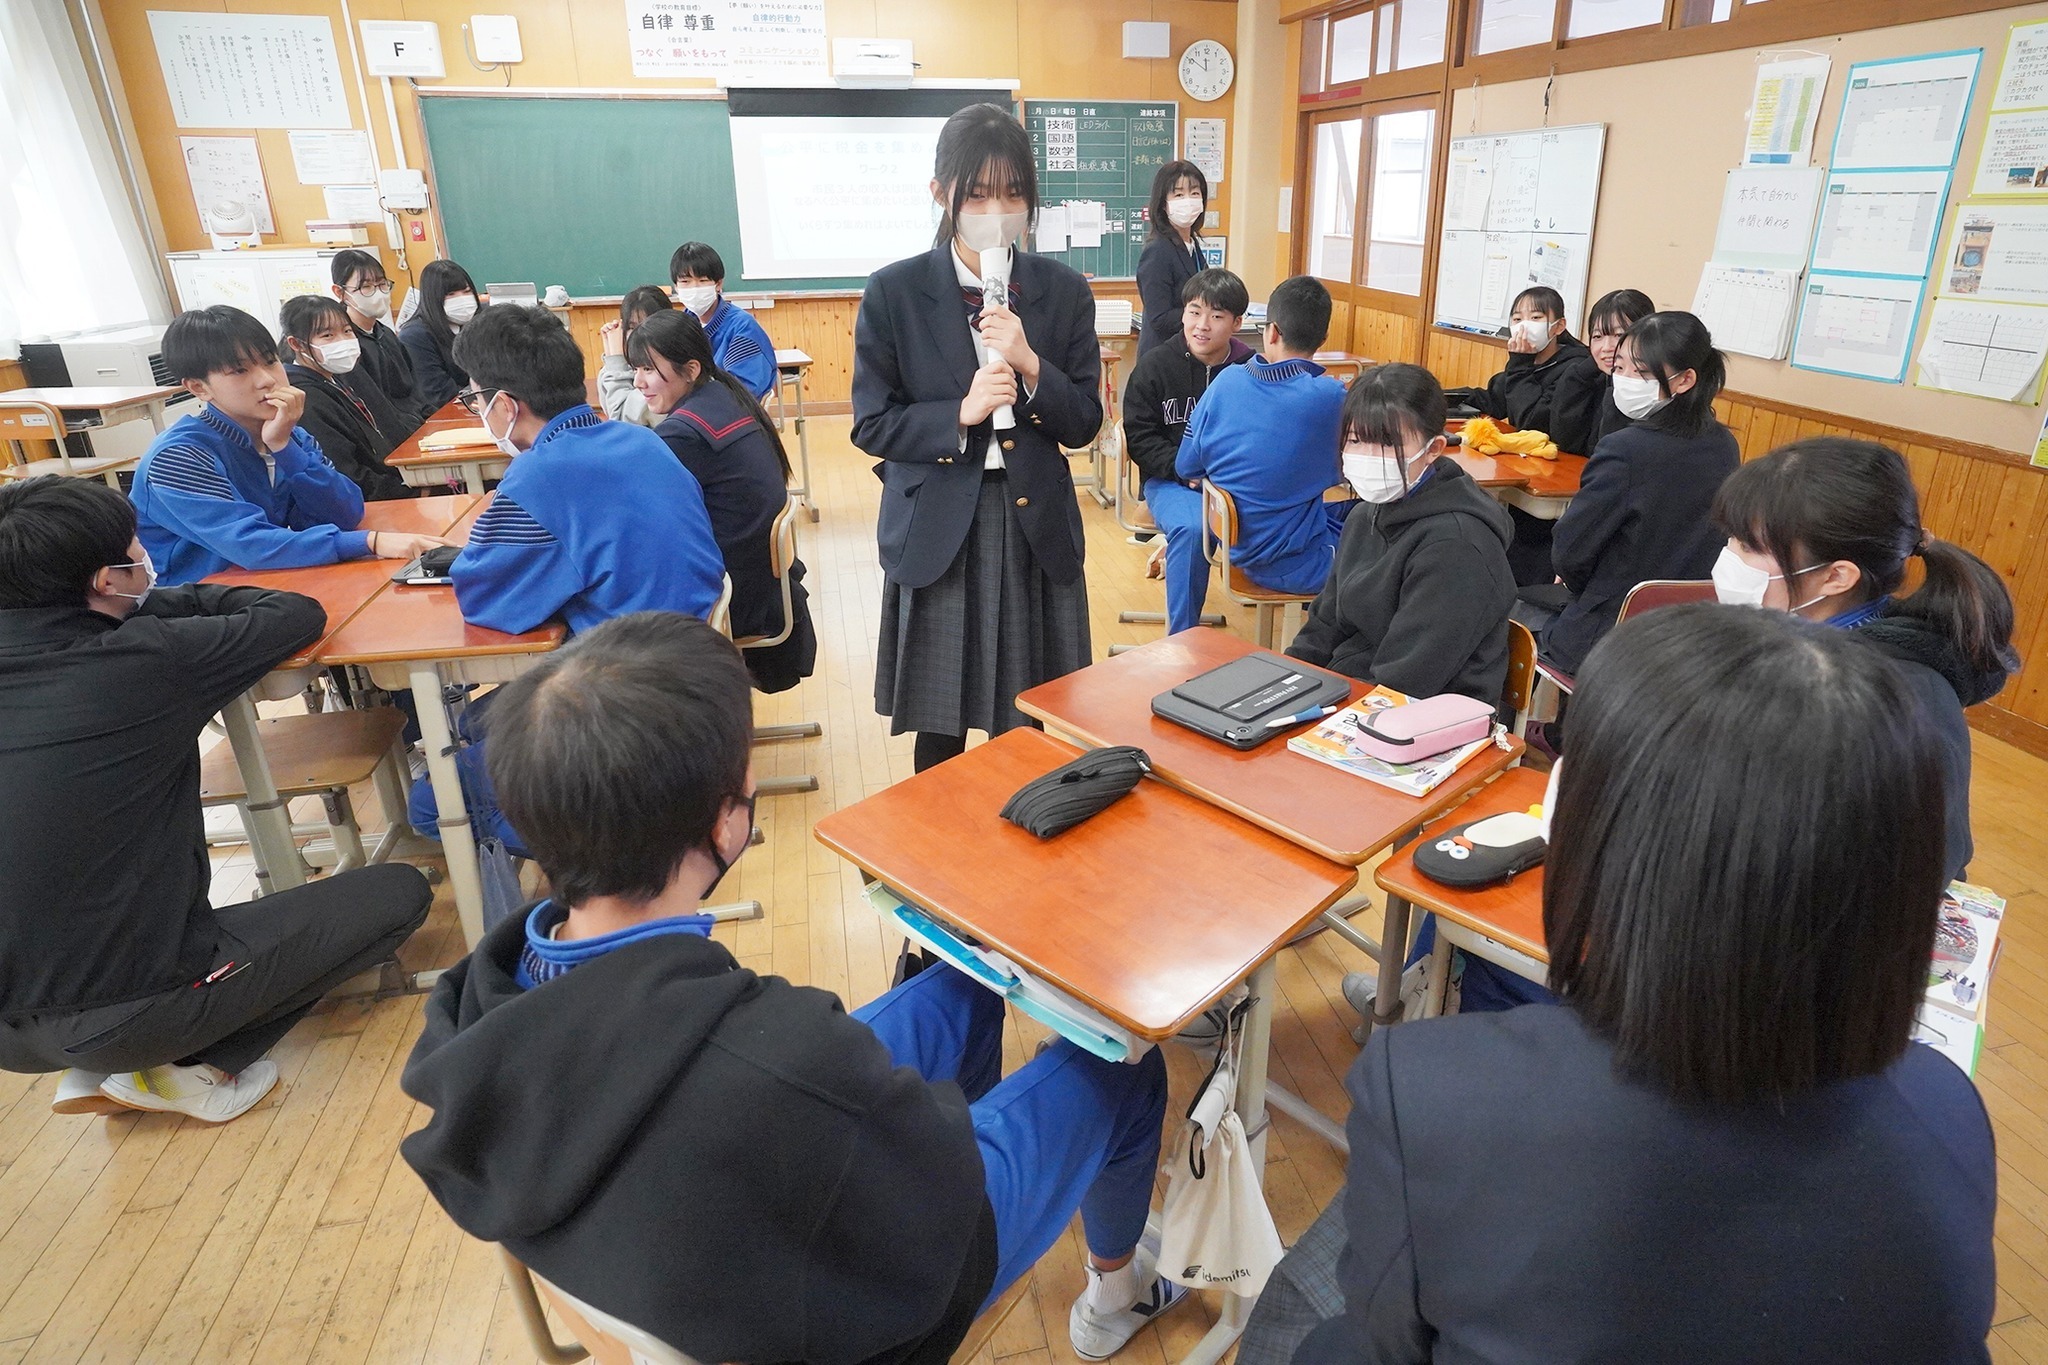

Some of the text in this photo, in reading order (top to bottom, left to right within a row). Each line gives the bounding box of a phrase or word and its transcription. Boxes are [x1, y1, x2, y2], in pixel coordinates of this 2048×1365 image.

[642, 13, 715, 31] 自律 尊重
[752, 13, 801, 23] 自律的行動力
[394, 42, 404, 57] F
[636, 48, 726, 58] つなぐ 願いをもって
[739, 47, 819, 55] コミュニケーション力
[1083, 108, 1096, 116] 日直
[1047, 120, 1074, 130] 技術
[1033, 132, 1075, 144] 2 国語
[1033, 146, 1075, 156] 3 数学
[859, 164, 898, 174] ワーク2
[1048, 159, 1075, 170] 社会
[1534, 217, 1556, 229] なし
